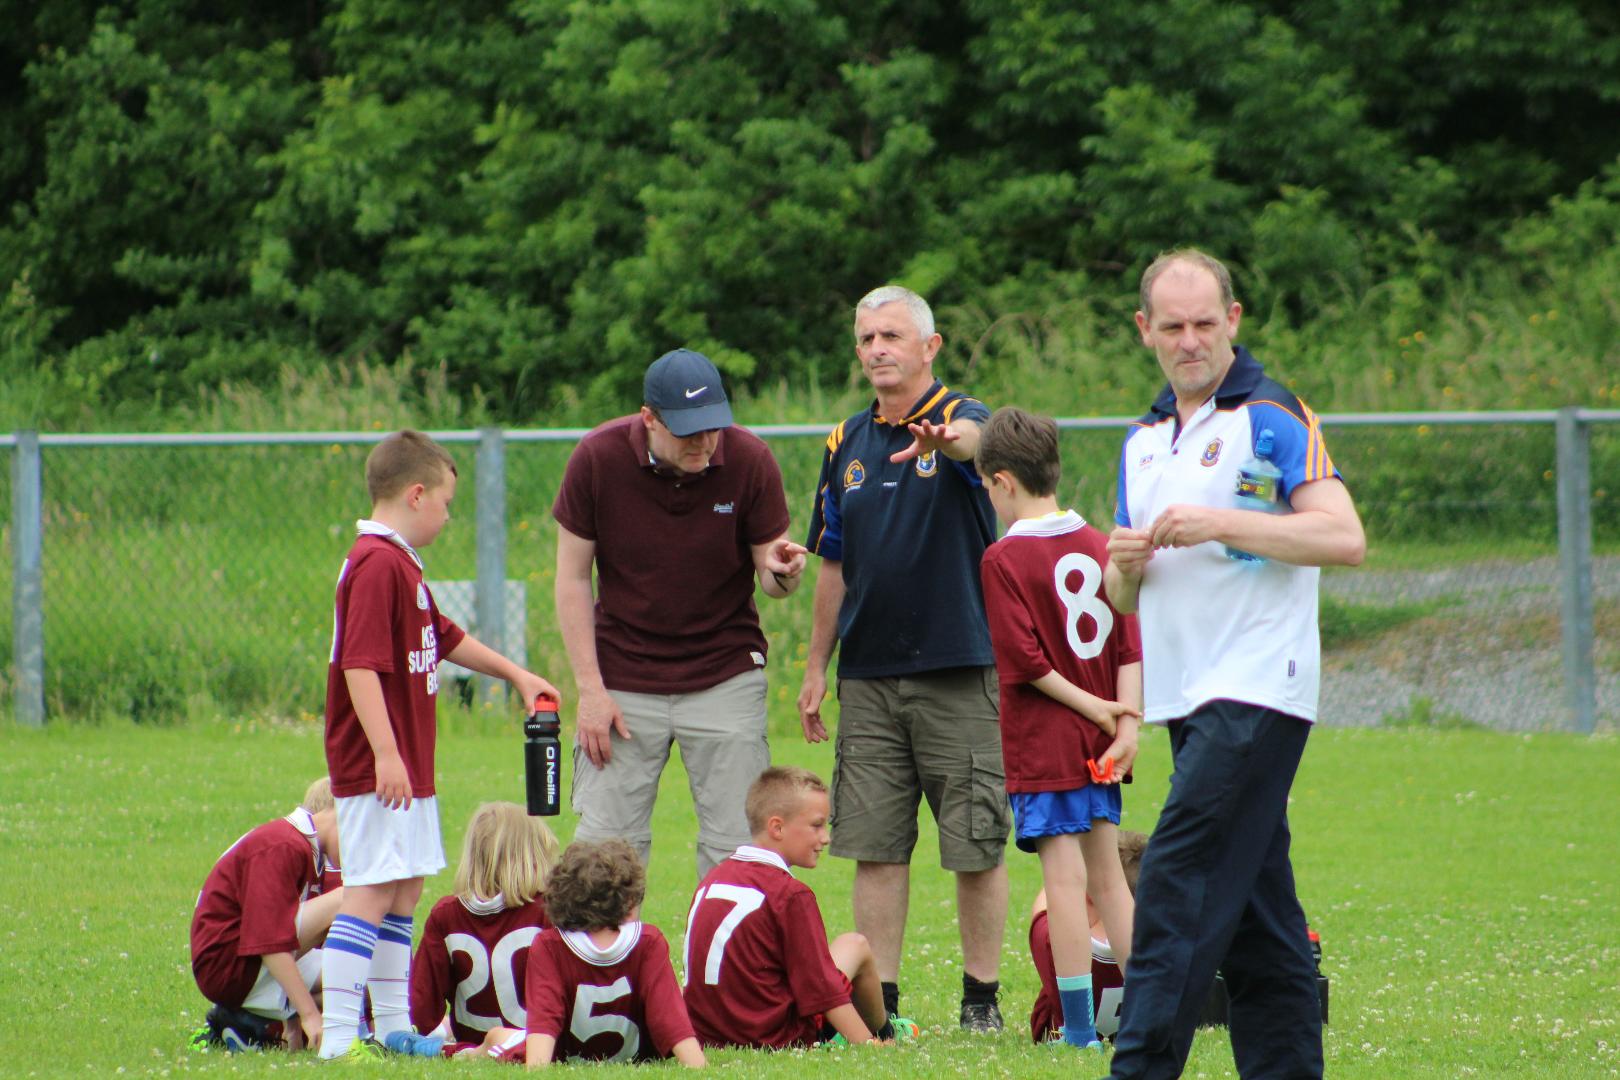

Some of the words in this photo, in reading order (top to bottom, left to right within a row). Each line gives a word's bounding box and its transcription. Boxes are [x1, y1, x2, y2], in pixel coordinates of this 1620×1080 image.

[1054, 552, 1113, 660] 8
[445, 926, 543, 1032] 20
[683, 883, 766, 987] 17
[570, 976, 640, 1062] 5
